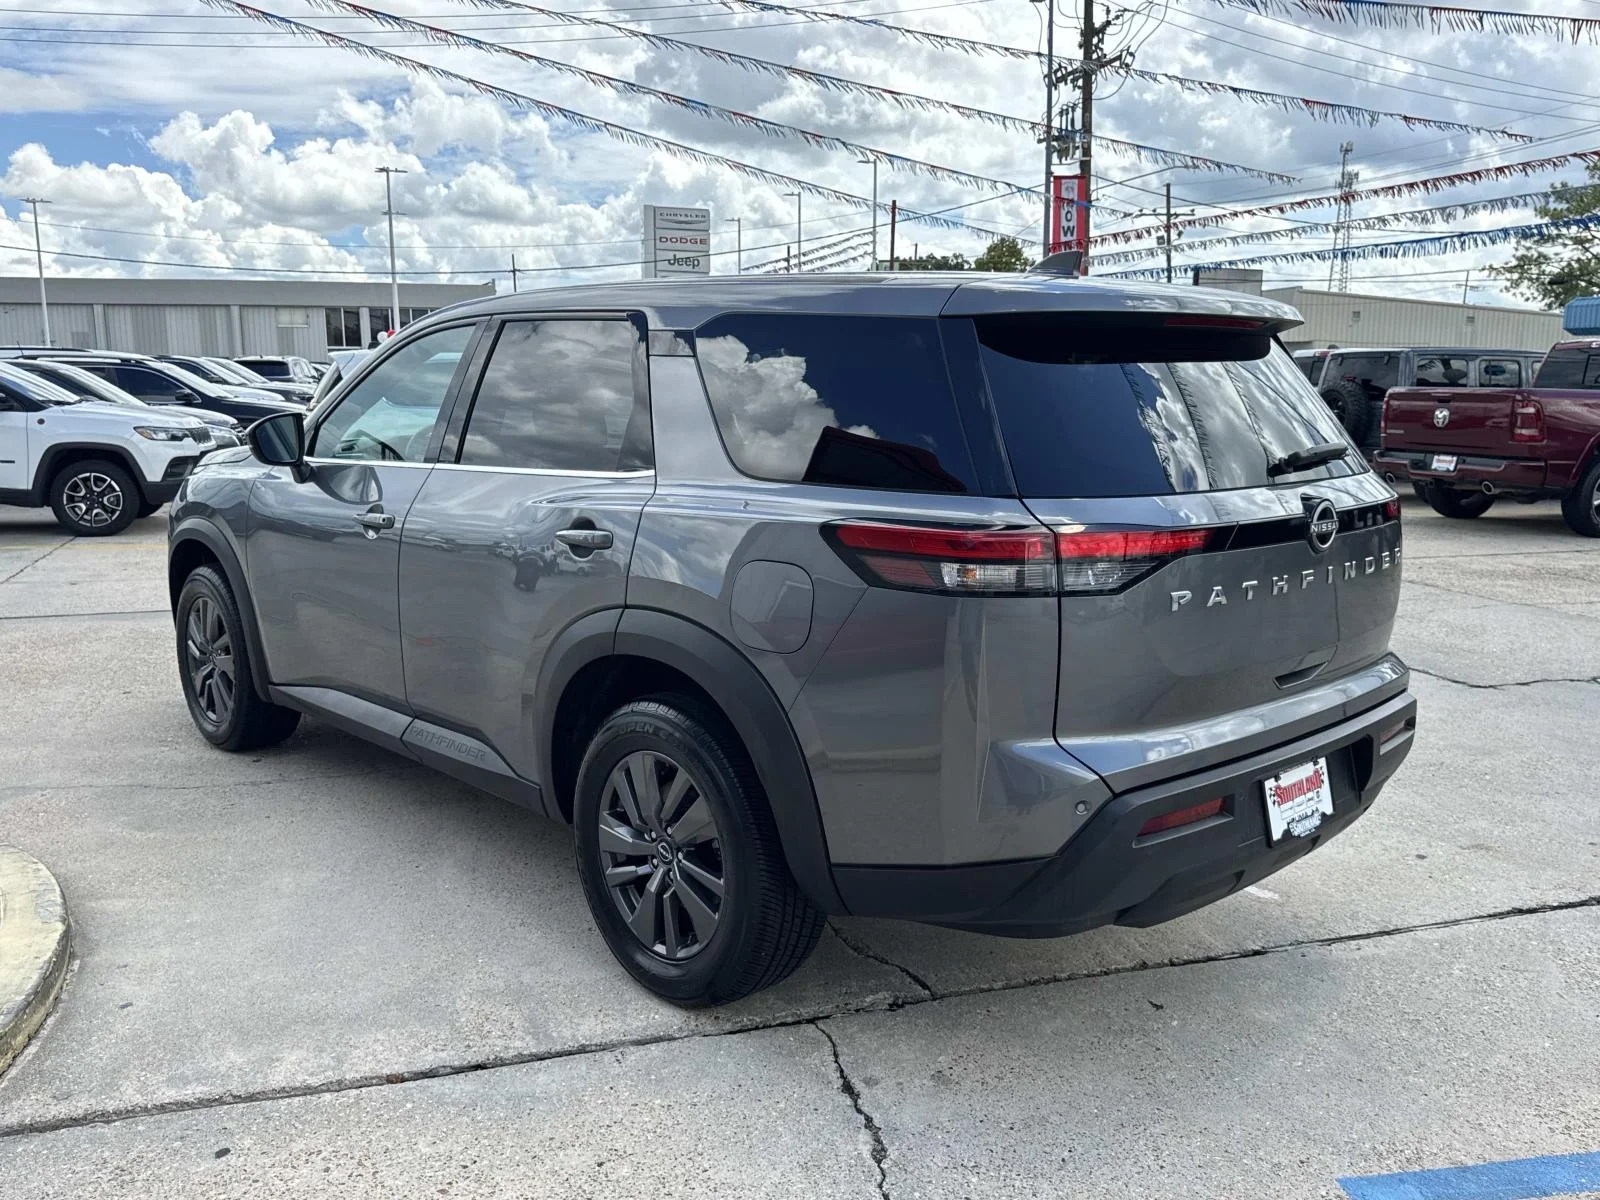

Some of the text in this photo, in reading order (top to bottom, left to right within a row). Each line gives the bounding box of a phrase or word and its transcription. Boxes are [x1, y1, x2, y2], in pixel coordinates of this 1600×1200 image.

[1062, 201, 1075, 238] OW
[659, 236, 708, 245] DODGE
[667, 253, 700, 269] Jeep
[1170, 547, 1400, 612] PATHFINDER
[409, 725, 486, 760] PATHFINDER
